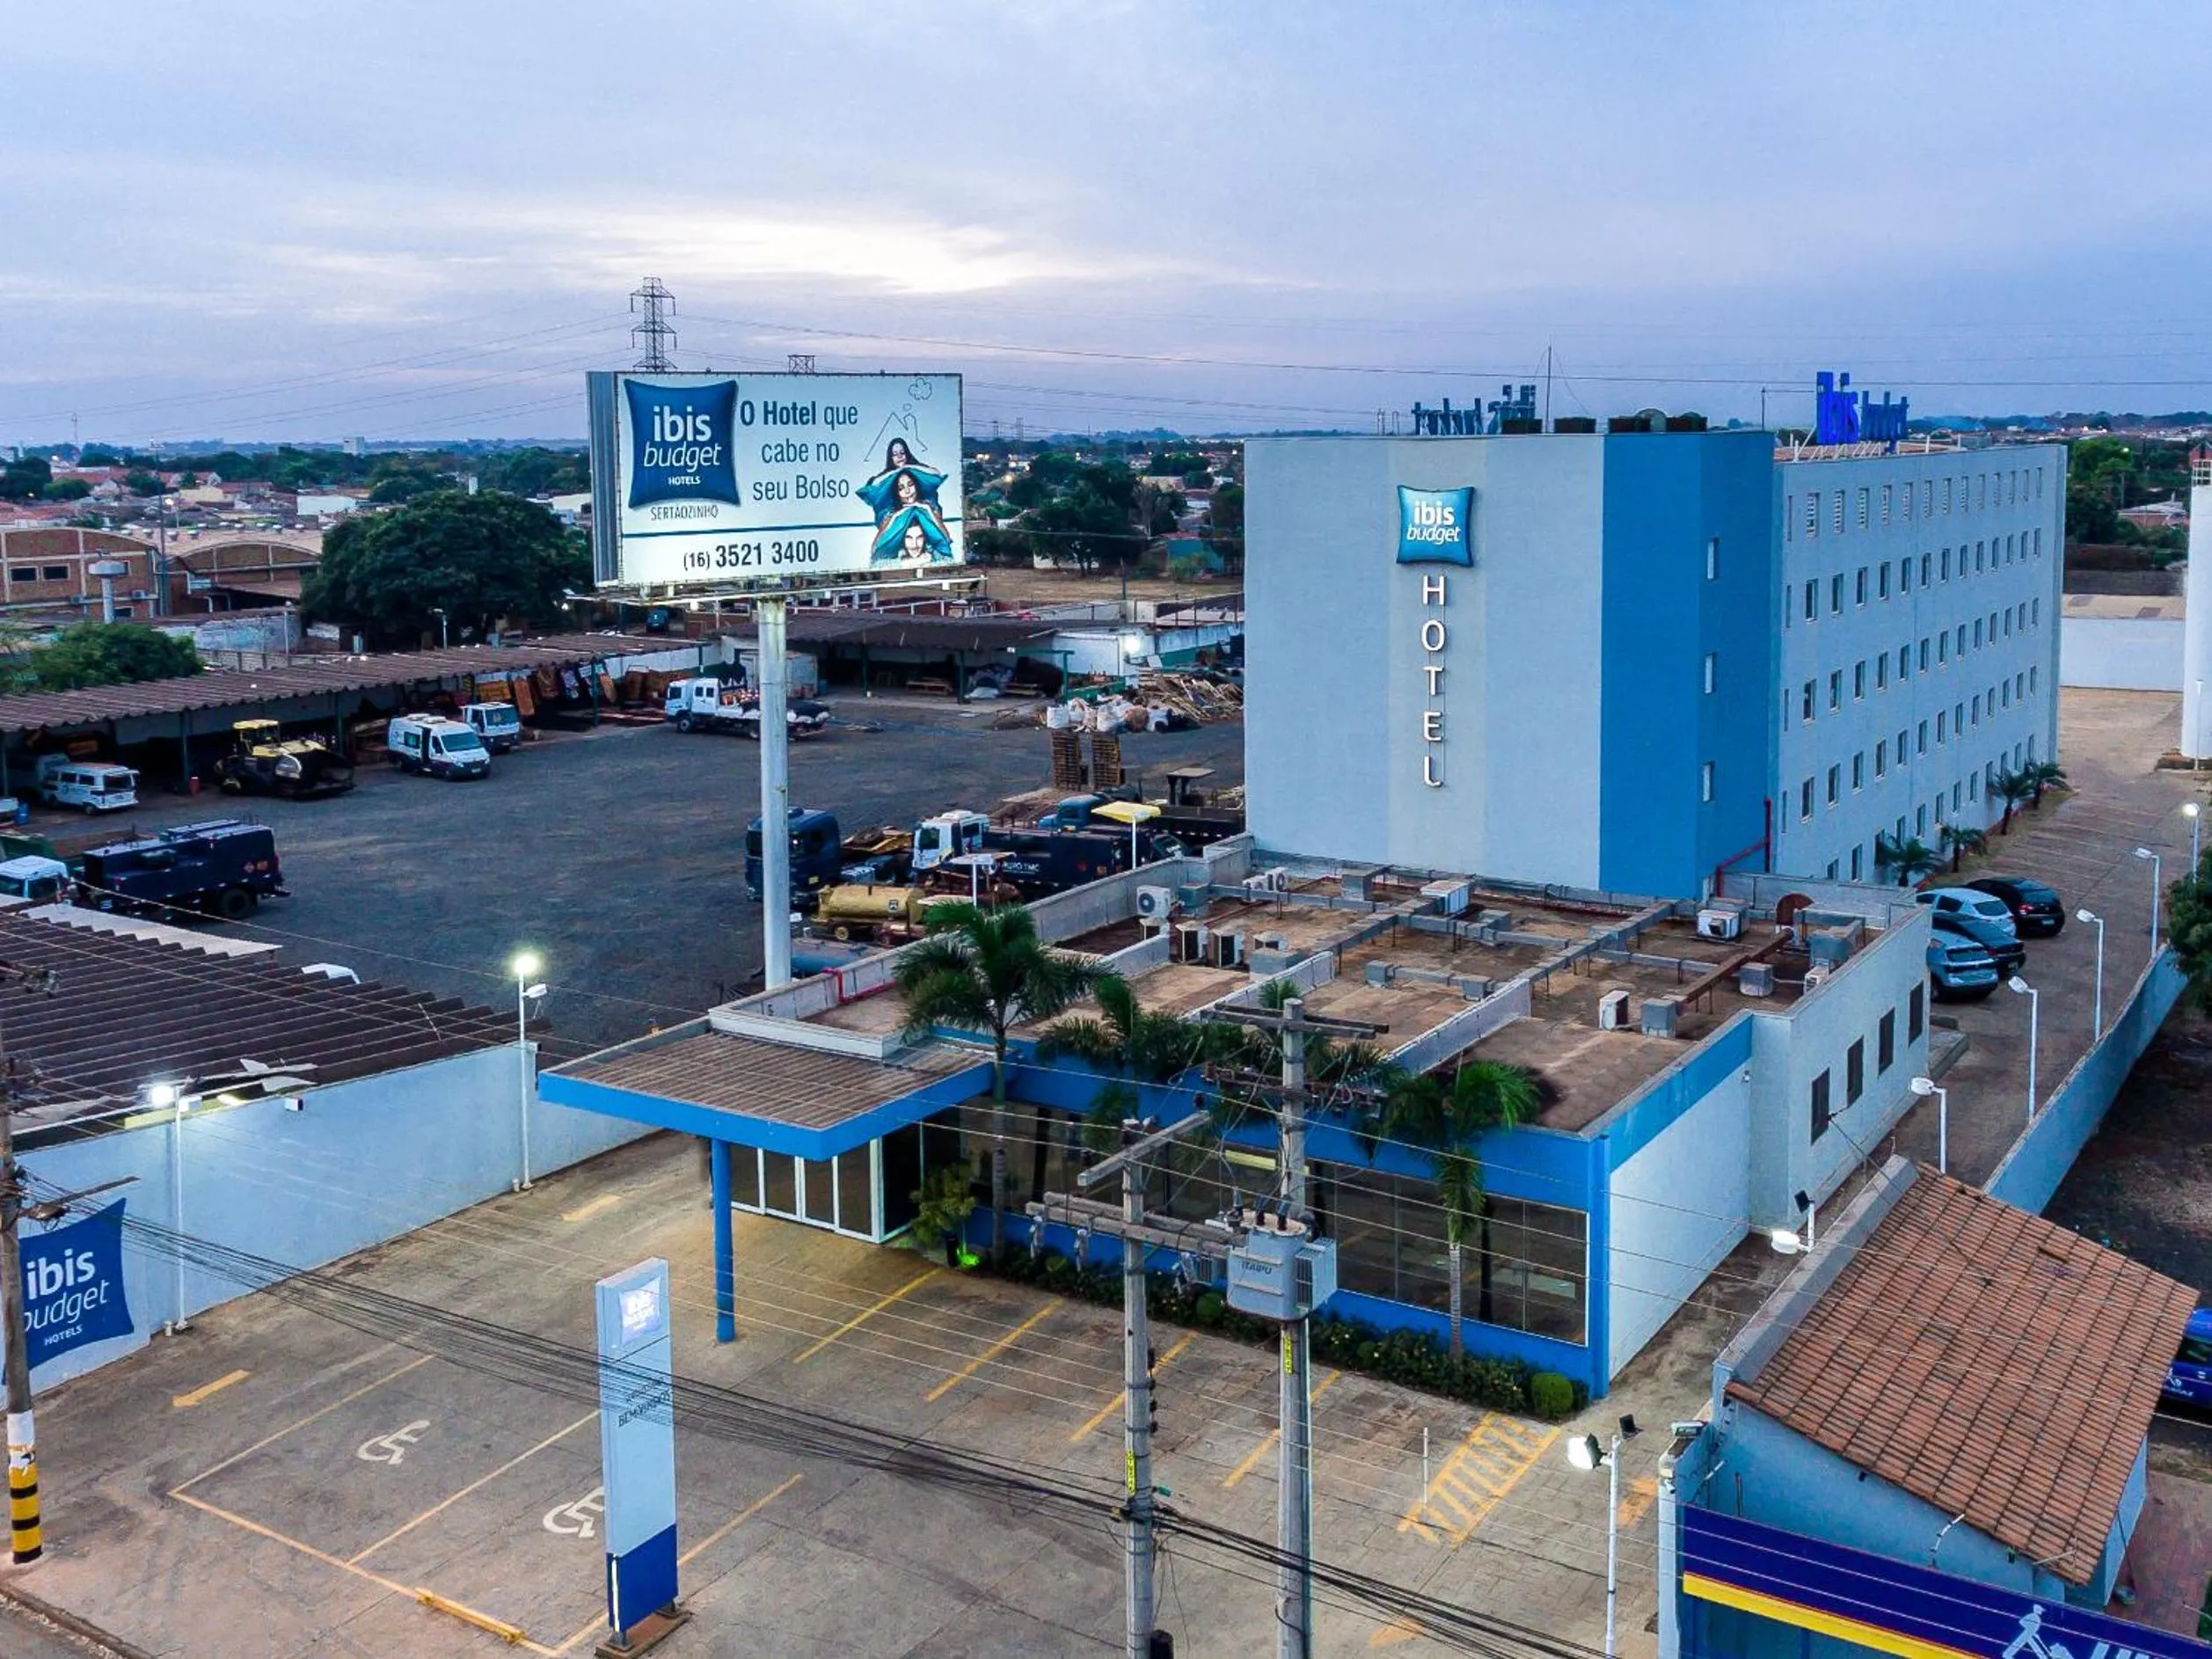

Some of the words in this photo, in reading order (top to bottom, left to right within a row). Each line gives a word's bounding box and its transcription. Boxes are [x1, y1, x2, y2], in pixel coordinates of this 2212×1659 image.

[653, 406, 712, 442] ibis
[741, 400, 755, 426] O
[763, 401, 816, 425] Hotel
[824, 406, 858, 431] que
[644, 441, 722, 472] budget
[762, 438, 808, 464] cabe
[816, 442, 839, 462] no
[668, 476, 702, 486] HOTELS
[753, 481, 787, 501] seu
[796, 474, 850, 500] Bolso
[1414, 501, 1455, 525] ibis
[1406, 523, 1461, 544] budget
[683, 552, 710, 571] (16)
[716, 542, 762, 567] 3521
[771, 539, 819, 564] 3400
[1420, 574, 1446, 787] HOTEL
[26, 1247, 96, 1301] ibis
[44, 1324, 84, 1346] HOTELS
